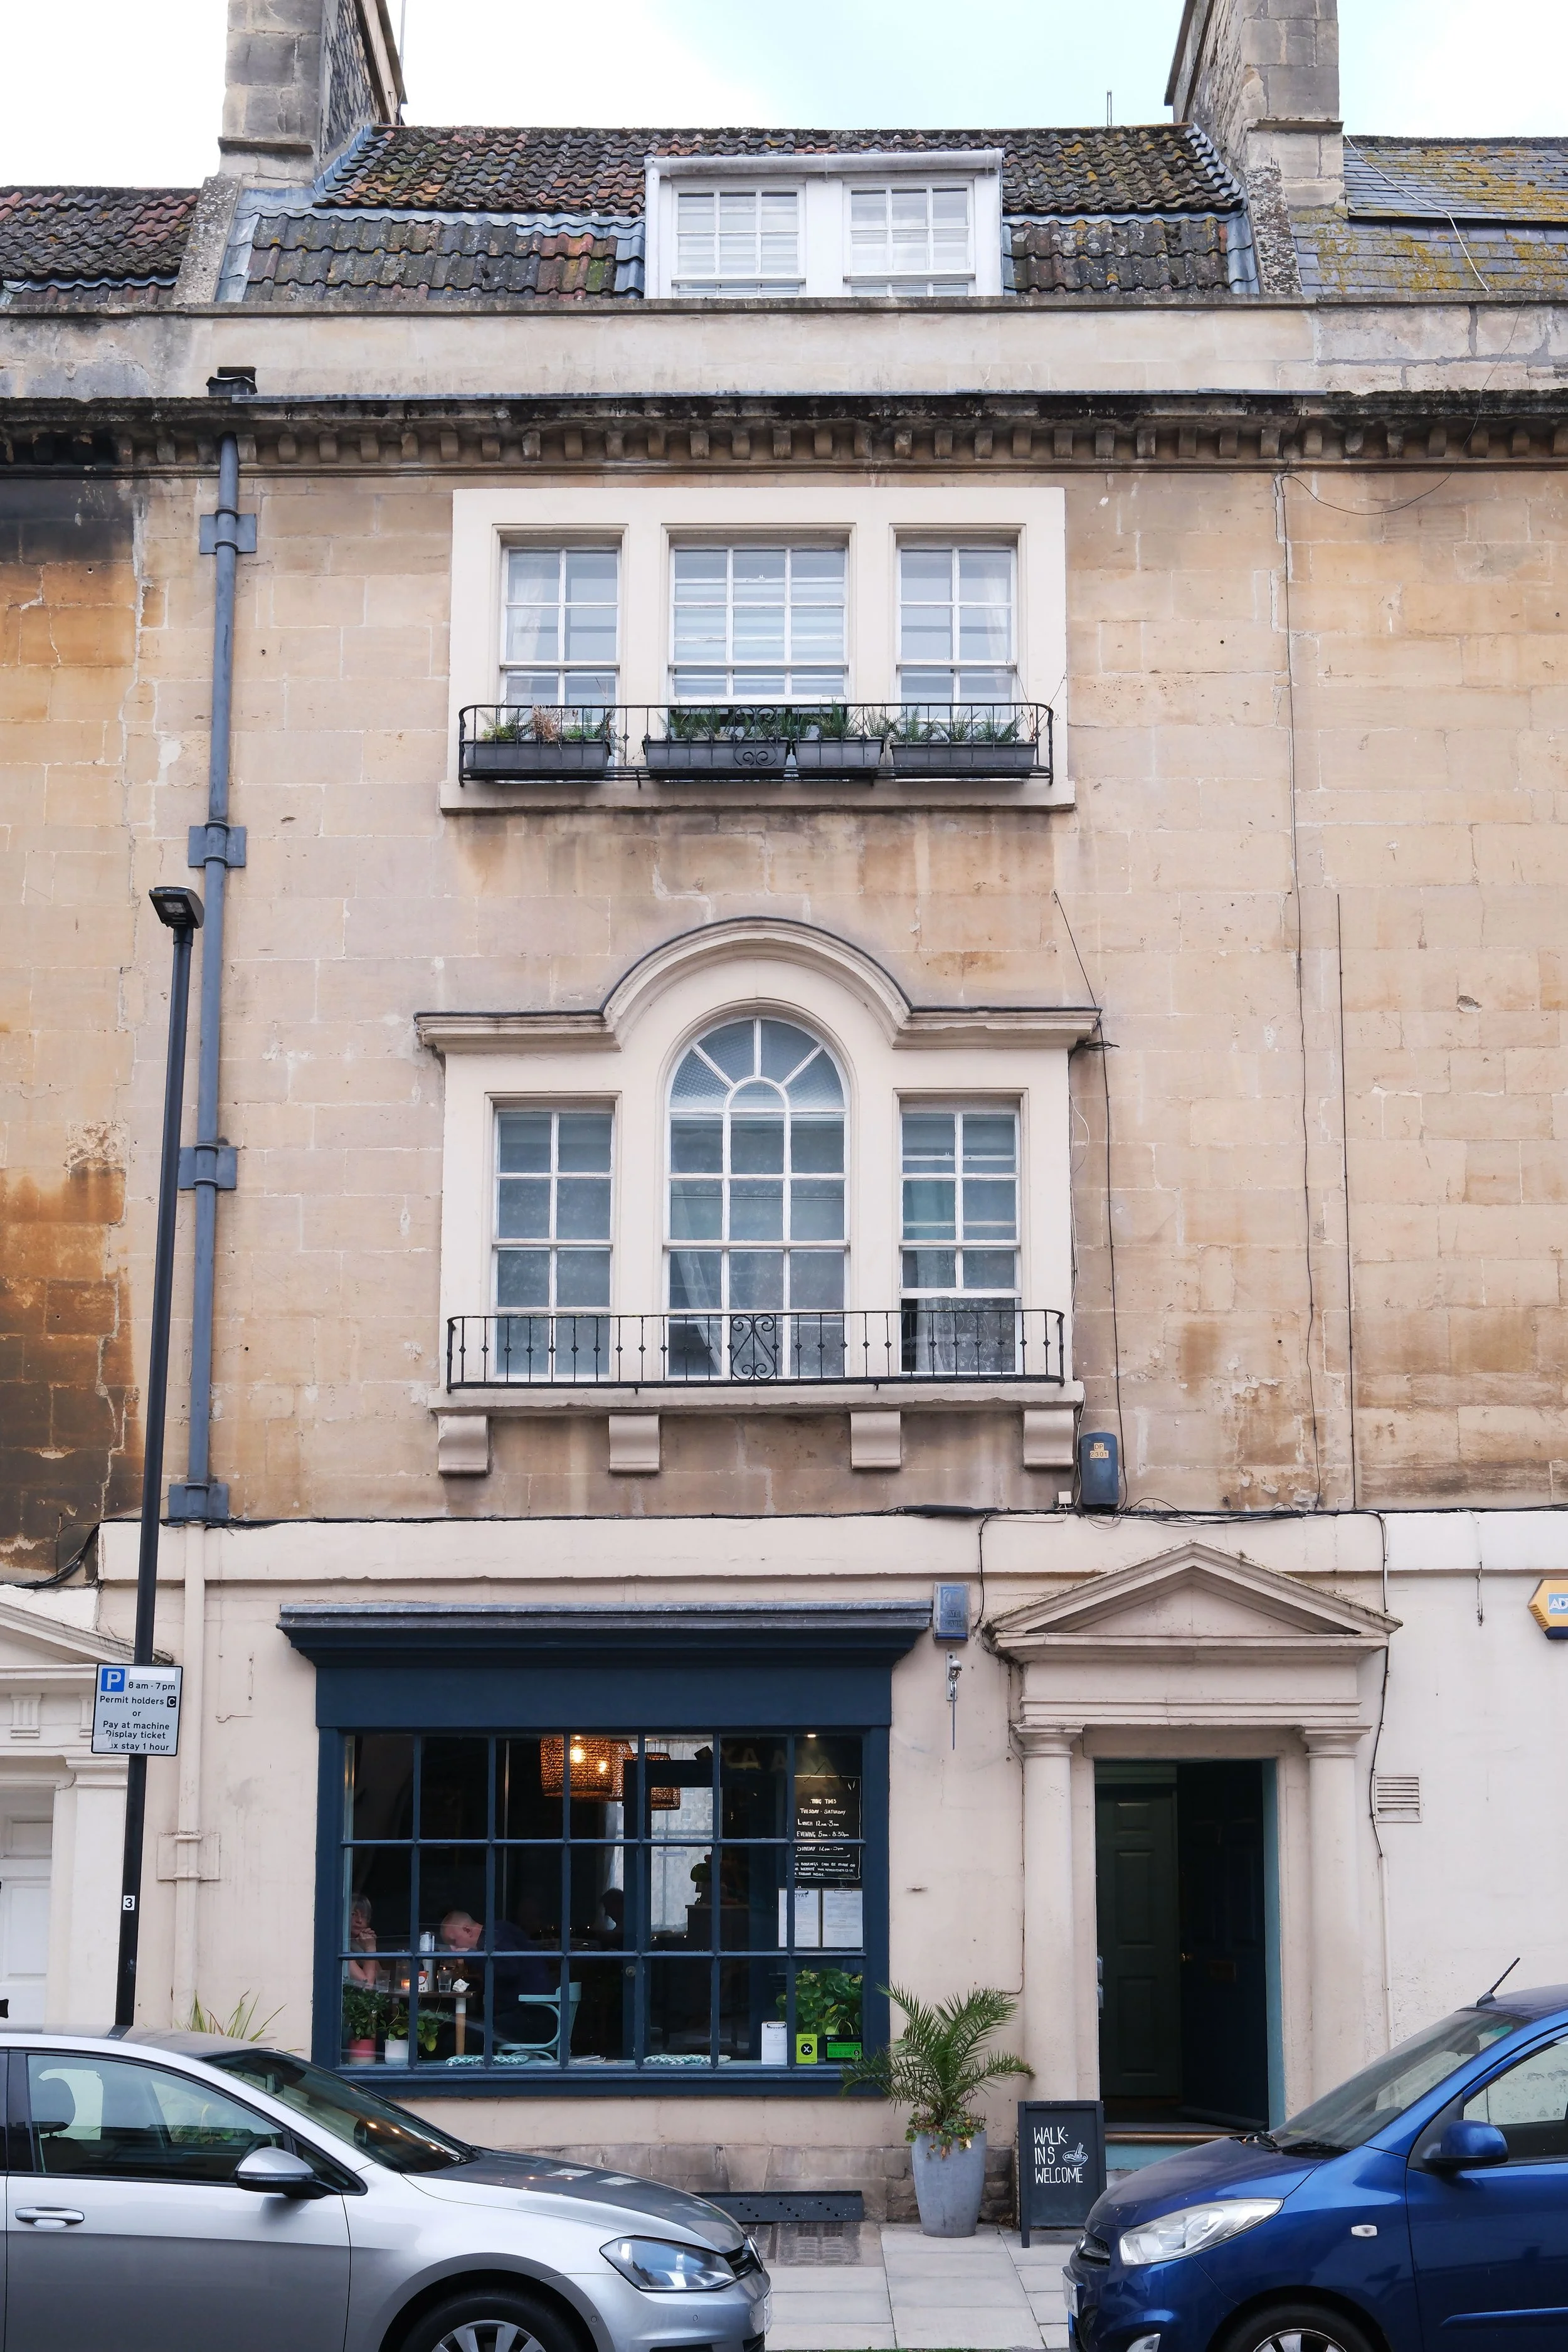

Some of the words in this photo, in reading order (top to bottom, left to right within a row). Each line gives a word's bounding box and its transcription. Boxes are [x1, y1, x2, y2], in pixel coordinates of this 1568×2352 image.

[1549, 1597, 1568, 1610] AD
[107, 1671, 121, 1690] P
[100, 1695, 129, 1703] Permit
[168, 1697, 176, 1706] C
[103, 1720, 119, 1729] Pay
[106, 1730, 137, 1739] Display
[140, 1731, 166, 1739] ticket
[121, 1742, 140, 1751] stay
[125, 1897, 133, 1908] 3
[1034, 2126, 1069, 2145] WALK-
[1034, 2146, 1056, 2164] INS
[1035, 2167, 1083, 2184] WELCOME
